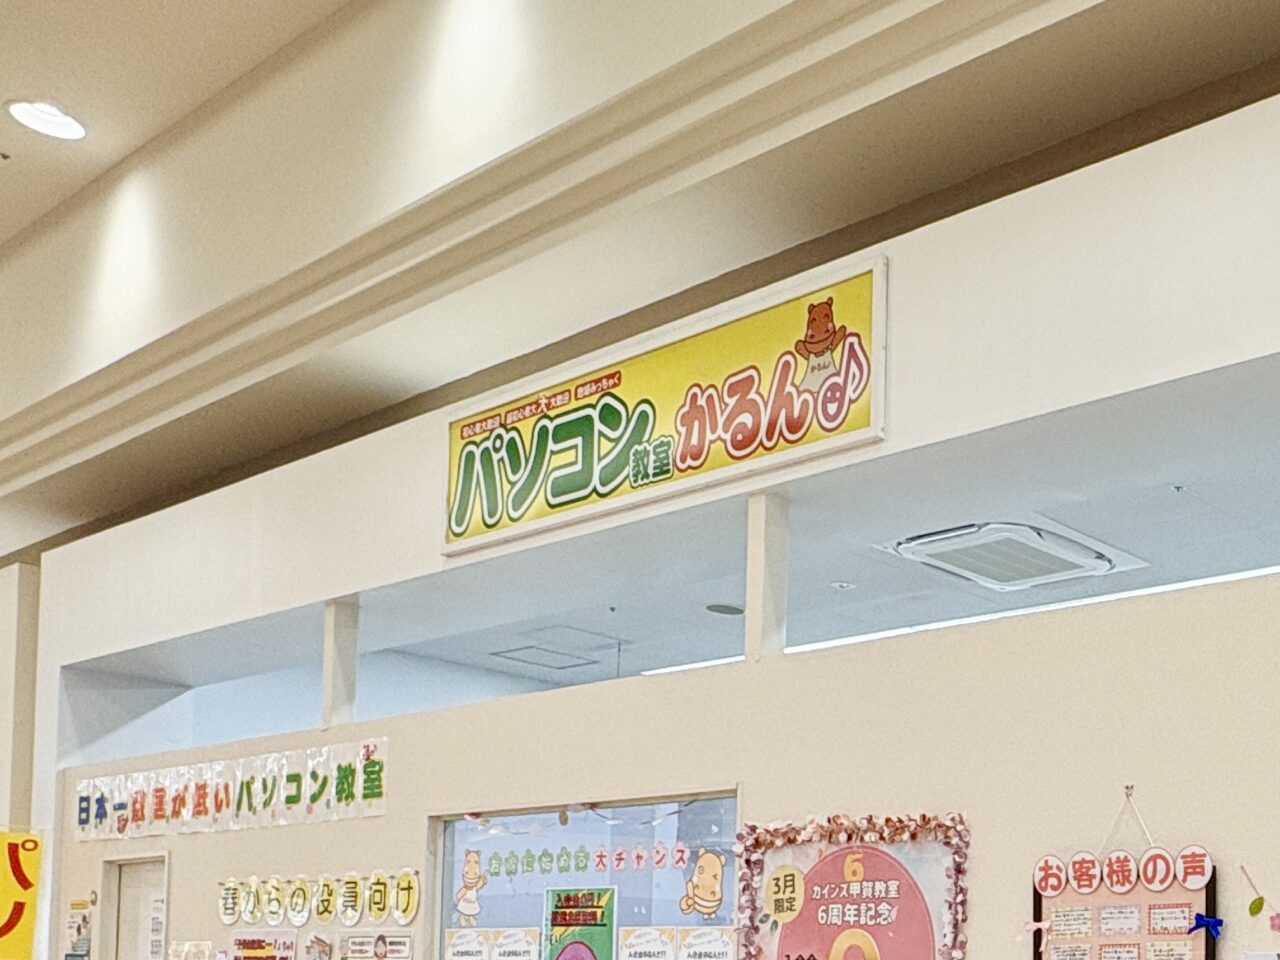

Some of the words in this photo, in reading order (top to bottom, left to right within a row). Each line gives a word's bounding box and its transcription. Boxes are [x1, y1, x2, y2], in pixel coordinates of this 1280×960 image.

[1037, 851, 1208, 893] お客様の声
[772, 874, 796, 895] 3月
[811, 880, 900, 900] カインズ甲賀教室
[774, 897, 797, 915] 限定
